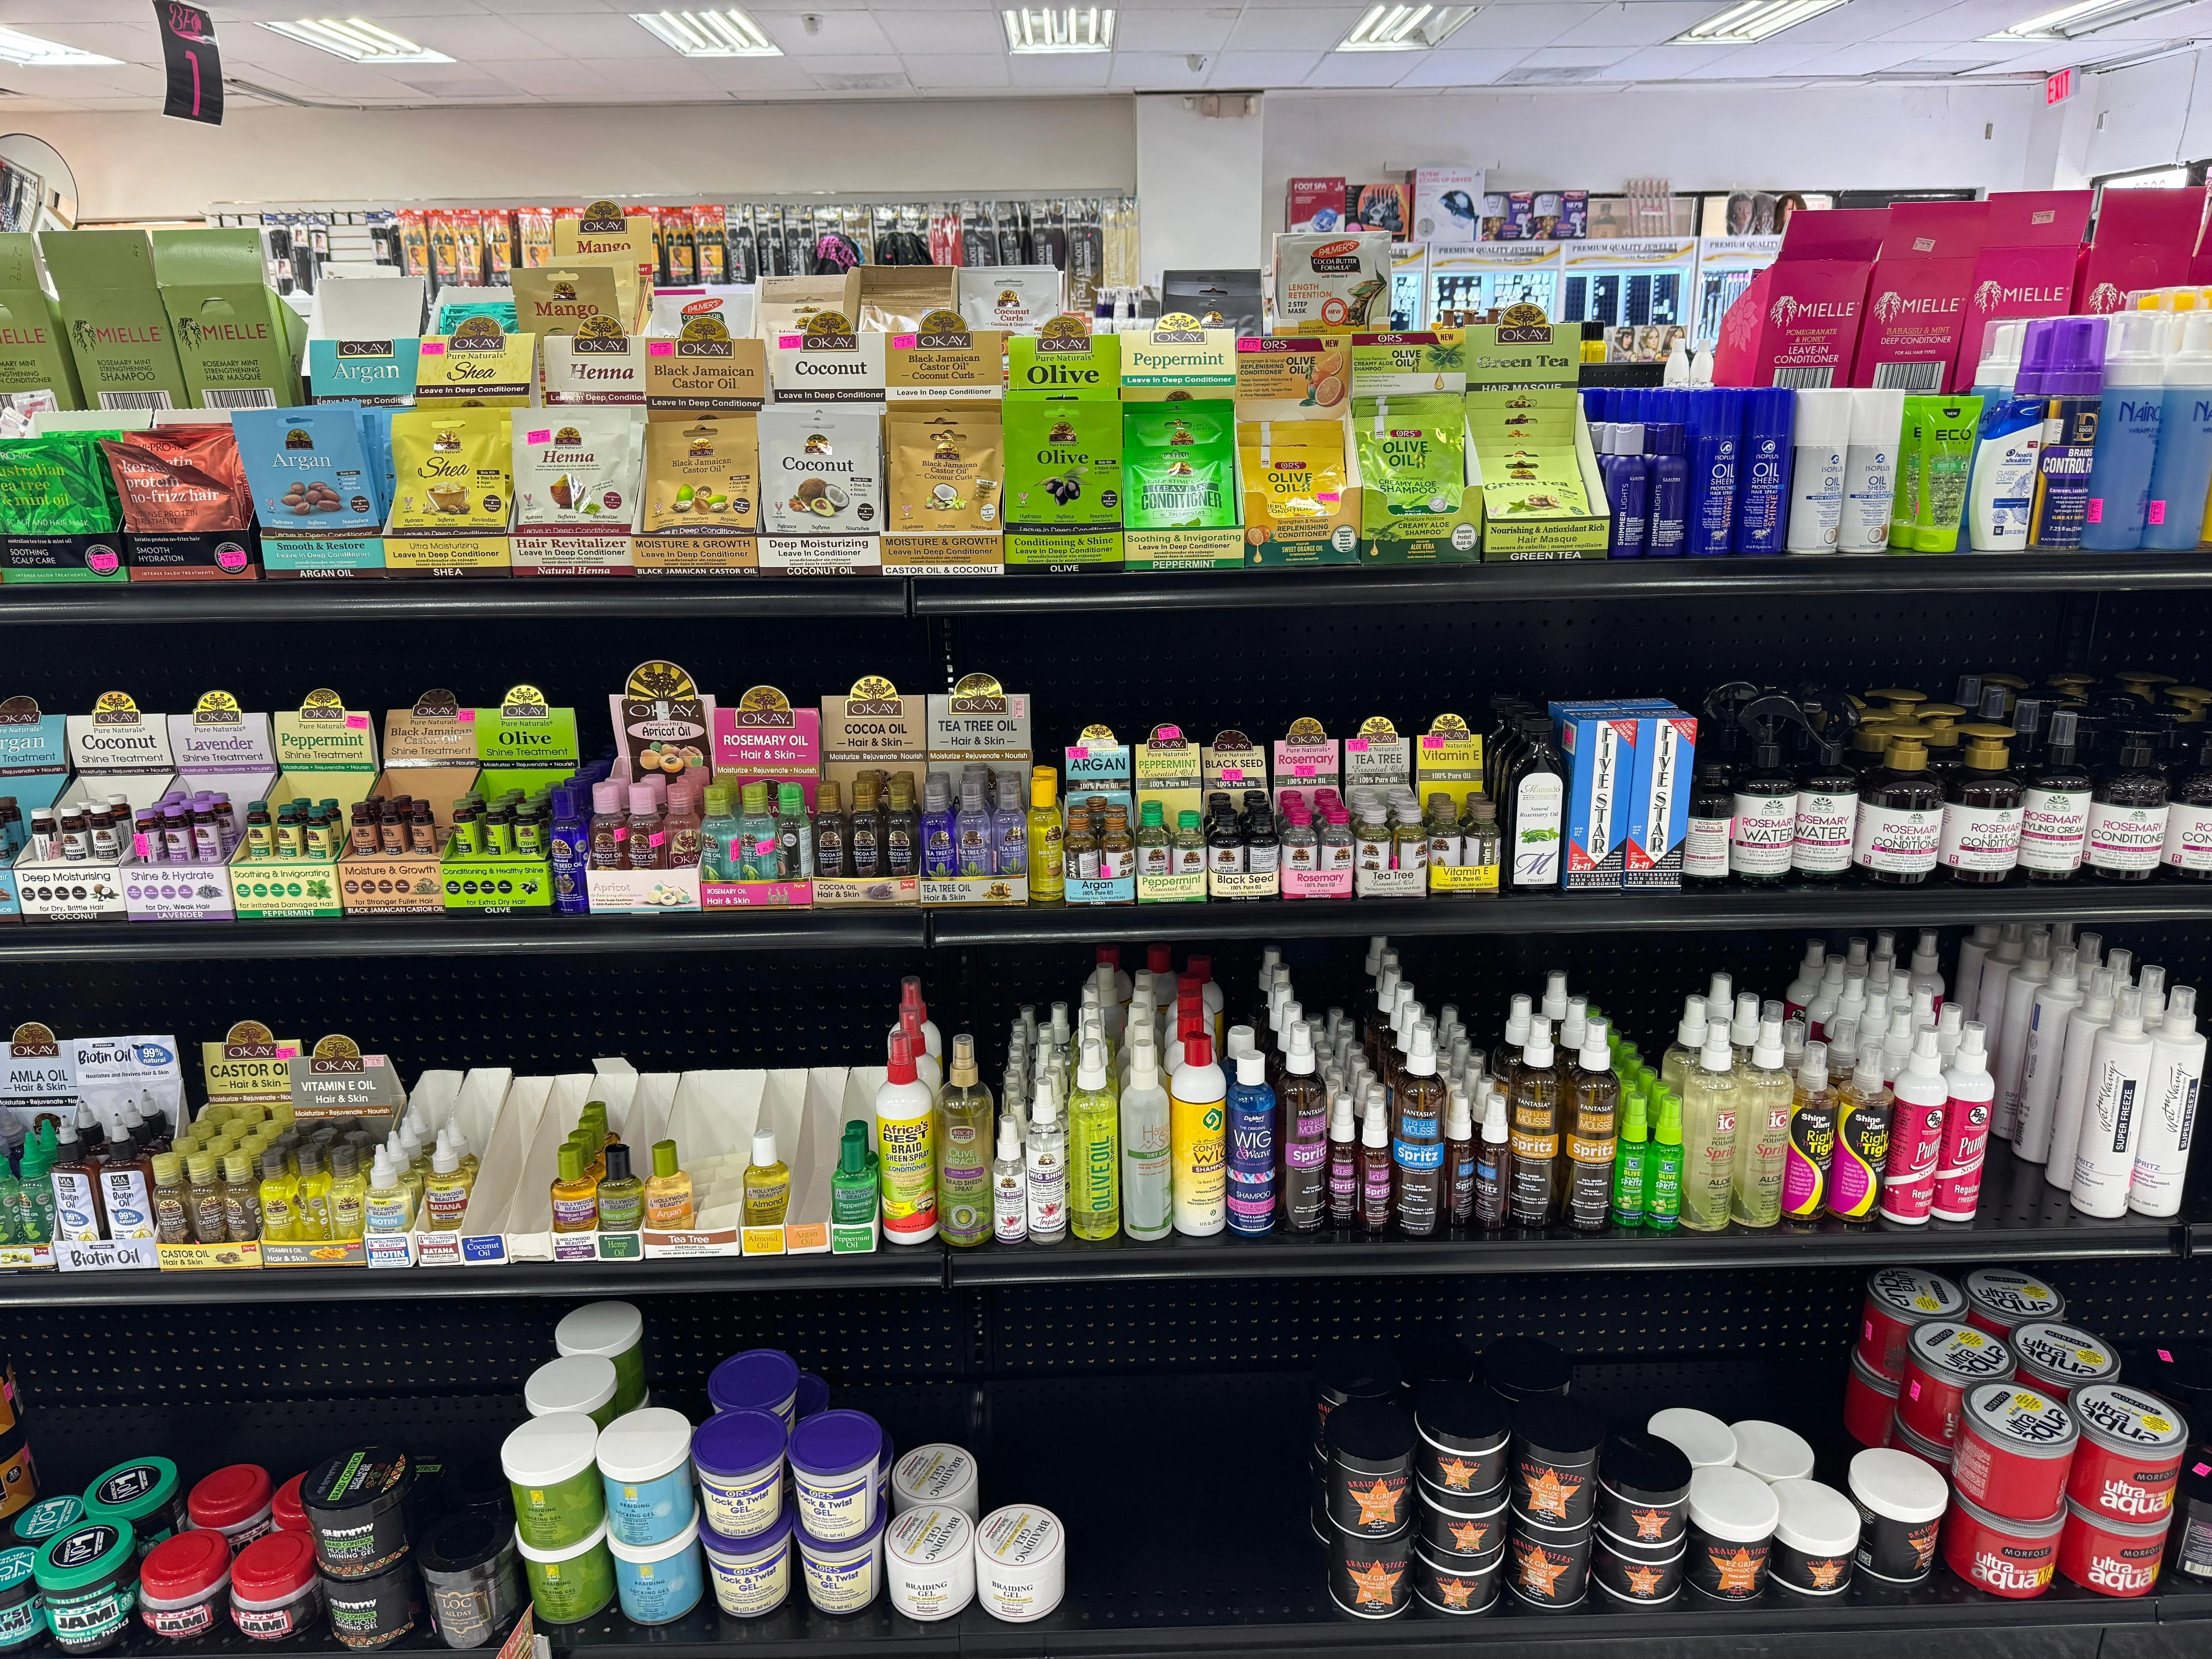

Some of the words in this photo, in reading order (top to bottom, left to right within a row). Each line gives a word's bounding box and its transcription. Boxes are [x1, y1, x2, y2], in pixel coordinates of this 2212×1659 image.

[2048, 69, 2070, 105] EXIT
[1319, 242, 1355, 256] PALMER'S
[1643, 243, 1678, 251] JEWELRY
[535, 302, 599, 318] Mango
[1798, 302, 1854, 318] MIELLE
[97, 327, 160, 344] MIELLE
[1262, 340, 1287, 349] ORS
[1788, 345, 1828, 354] LEAVE-IN
[1134, 353, 1224, 369] Peppermint
[1477, 356, 1532, 369] Green
[1537, 356, 1569, 368] Tea
[1774, 354, 1839, 363] CONDITIONER
[101, 372, 155, 381] SHAMPOO
[448, 362, 496, 381] Shea
[655, 366, 689, 376] Black
[693, 366, 754, 377] Jamaican
[1027, 365, 1099, 384] Olive
[672, 378, 714, 388] Castor
[717, 378, 737, 388] Oil
[455, 387, 475, 395] Deep
[477, 385, 524, 394] Conditioner
[1936, 429, 1971, 440] ECO
[1383, 442, 1428, 454] OLIVE
[273, 453, 332, 471] Argan
[1389, 454, 1414, 467] OIL
[1753, 463, 1779, 477] OIL
[130, 491, 186, 504] no-frizz
[190, 489, 219, 502] hair
[1491, 527, 1533, 535] Nourishing
[517, 539, 548, 547] Hair
[552, 539, 626, 547] Revitalizer
[1015, 537, 1076, 547] Conditioning
[1087, 537, 1113, 545] Shine
[1128, 535, 1170, 543] Soothing
[1184, 534, 1241, 543] Invigorating
[1153, 560, 1216, 569] PEPPERMINT
[938, 721, 960, 731] TEA
[965, 721, 995, 731] TREE
[998, 721, 1017, 731] OIL
[642, 727, 674, 737] Apricot
[677, 727, 691, 736] Oil
[83, 735, 156, 750] Coconut
[186, 737, 253, 751] Lavender
[724, 735, 787, 746] ROSEMARY
[789, 735, 808, 746] OIL
[741, 750, 761, 760] Hair
[764, 750, 772, 759] &
[775, 750, 795, 759] Skin
[1279, 755, 1334, 765] Rosemary
[1071, 759, 1125, 771] ARGAN
[1139, 760, 1196, 769] PEPPERMINT
[1206, 760, 1238, 768] BLACK
[1883, 823, 1939, 834] ROSEMARY
[1744, 828, 1792, 842] WATER
[345, 866, 387, 875] Moisture
[398, 866, 436, 874] Growth
[22, 872, 50, 883] Deep
[53, 872, 111, 881] Moisturising
[78, 1051, 111, 1064] Biotin
[114, 1049, 130, 1062] Oil
[143, 1048, 163, 1058] 99%
[10, 1071, 45, 1082] AMLA
[48, 1070, 68, 1081] OIL
[2120, 1089, 2133, 1121] FREEZE
[1801, 1113, 1826, 1122] Shine
[883, 1131, 926, 1142] BEST
[1404, 1126, 1437, 1136] MOUSSE
[2116, 1123, 2127, 1150] SUPER
[1235, 1130, 1270, 1147] WIG
[892, 1144, 922, 1153] BRAID
[1091, 1135, 1109, 1162] OIL
[886, 1151, 909, 1161] SHEEN
[910, 1148, 930, 1158] SPRAY
[1398, 1150, 1437, 1161] Spritz
[1029, 1171, 1042, 1180] WIG
[1709, 1177, 1730, 1185] ALOE
[1091, 1163, 1110, 1211] OLIVE
[1236, 1191, 1270, 1199] SHAMPOO
[668, 1235, 684, 1243] Tea
[687, 1235, 709, 1243] Tree
[372, 1249, 405, 1258] BIOTIN
[1348, 1478, 1406, 1487] BRAIDMASTERS
[712, 1495, 732, 1506] Lock
[747, 1490, 769, 1504] Twist
[2005, 1548, 2049, 1557] MORFOSE
[1975, 1552, 2013, 1573] ultra
[1971, 1565, 2037, 1589] aqua
[906, 1582, 947, 1590] BRAIDING
[443, 1599, 471, 1608] LOC
[58, 1603, 117, 1629] JAM!
[56, 1634, 98, 1645] regular
[102, 1618, 129, 1637] hold
